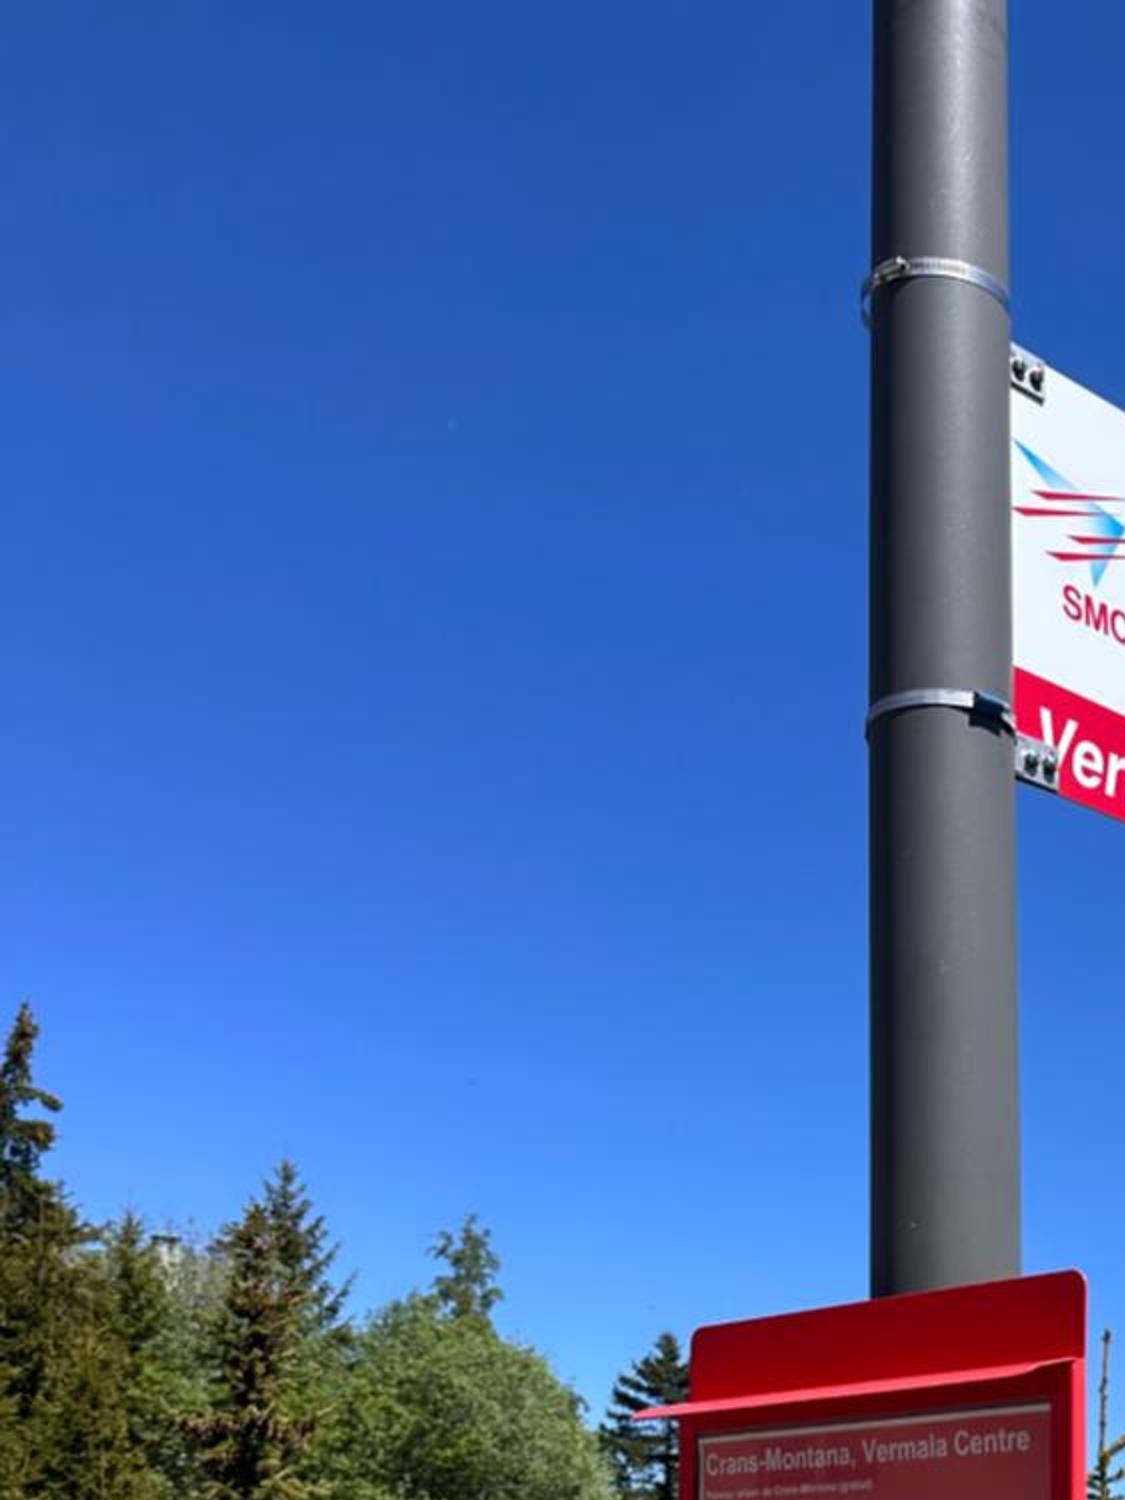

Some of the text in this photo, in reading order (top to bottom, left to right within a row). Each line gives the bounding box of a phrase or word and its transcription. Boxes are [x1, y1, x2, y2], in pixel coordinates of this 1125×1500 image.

[705, 1427, 1031, 1476] Crans-Montana, Vermala Centre
